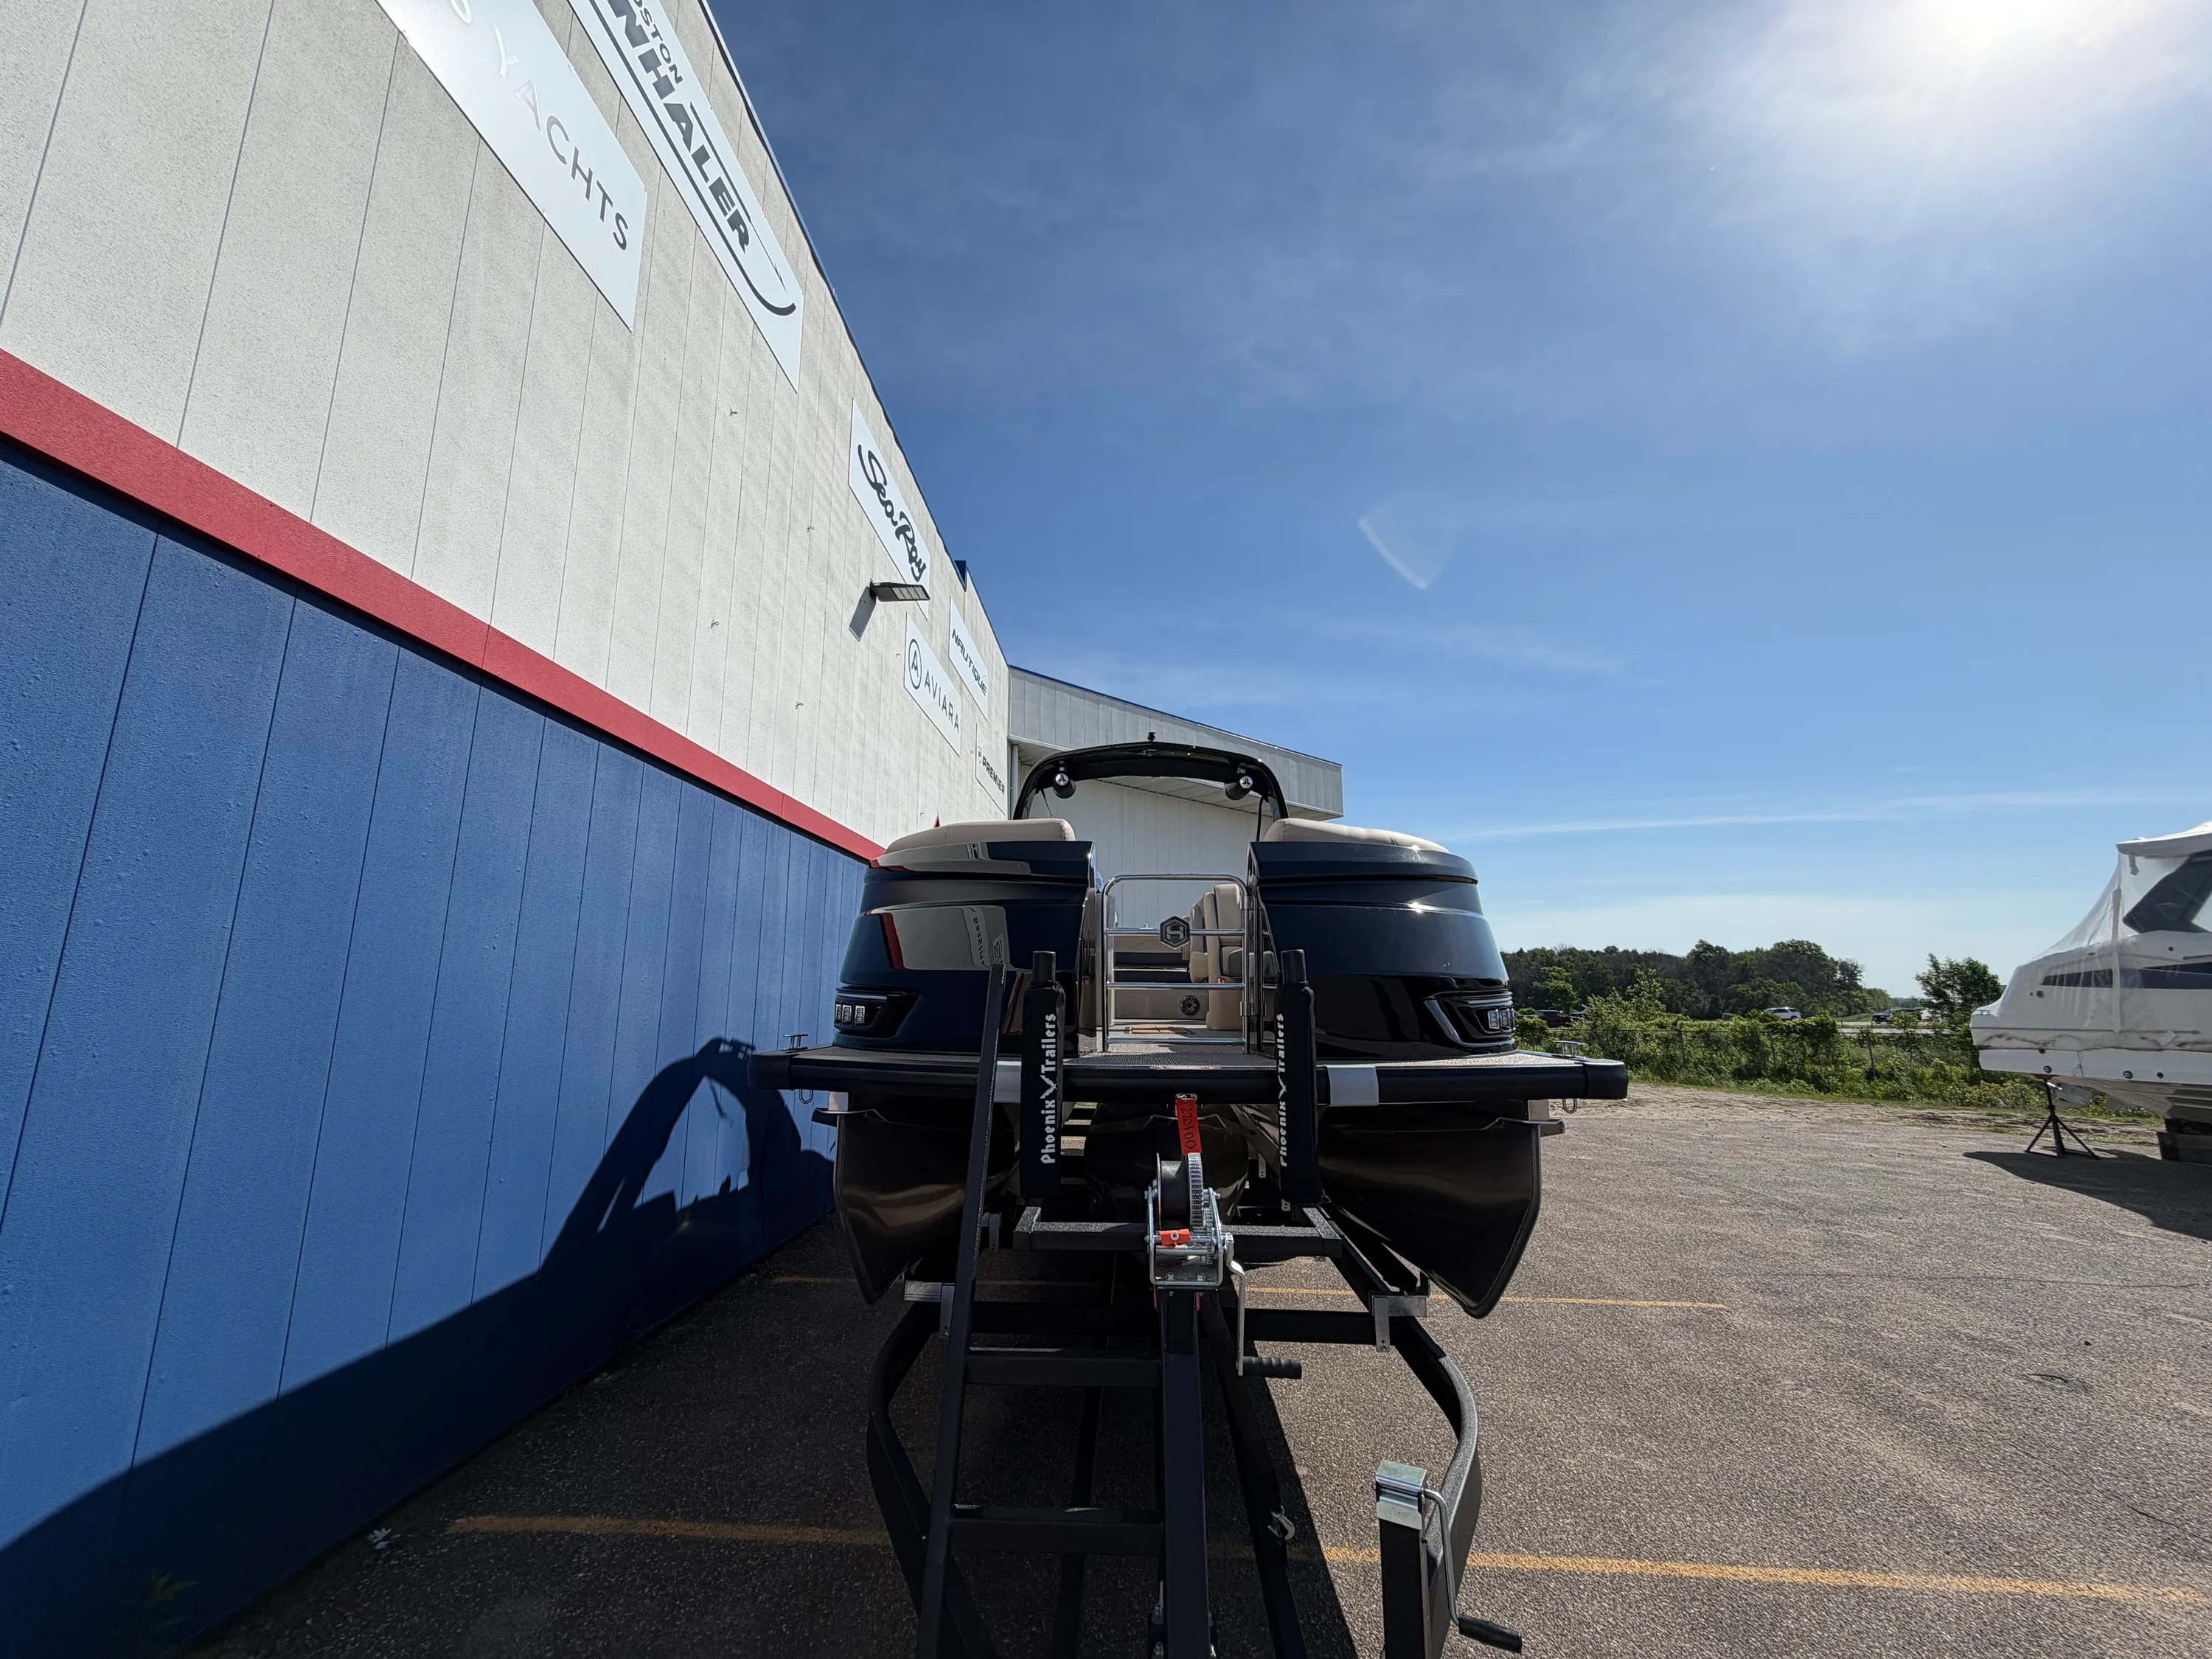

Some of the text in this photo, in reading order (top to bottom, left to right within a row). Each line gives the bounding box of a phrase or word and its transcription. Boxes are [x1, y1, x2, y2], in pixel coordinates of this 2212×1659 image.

[495, 24, 628, 251] YACHTS
[858, 444, 927, 582] Sea Ray
[924, 669, 959, 734] AVIARA
[952, 628, 987, 696] NAUTIQUE
[982, 754, 1006, 796] PREMIER
[1040, 1013, 1057, 1164] Phoenix Trailers
[1276, 1013, 1287, 1167] Phoenix Trailers
